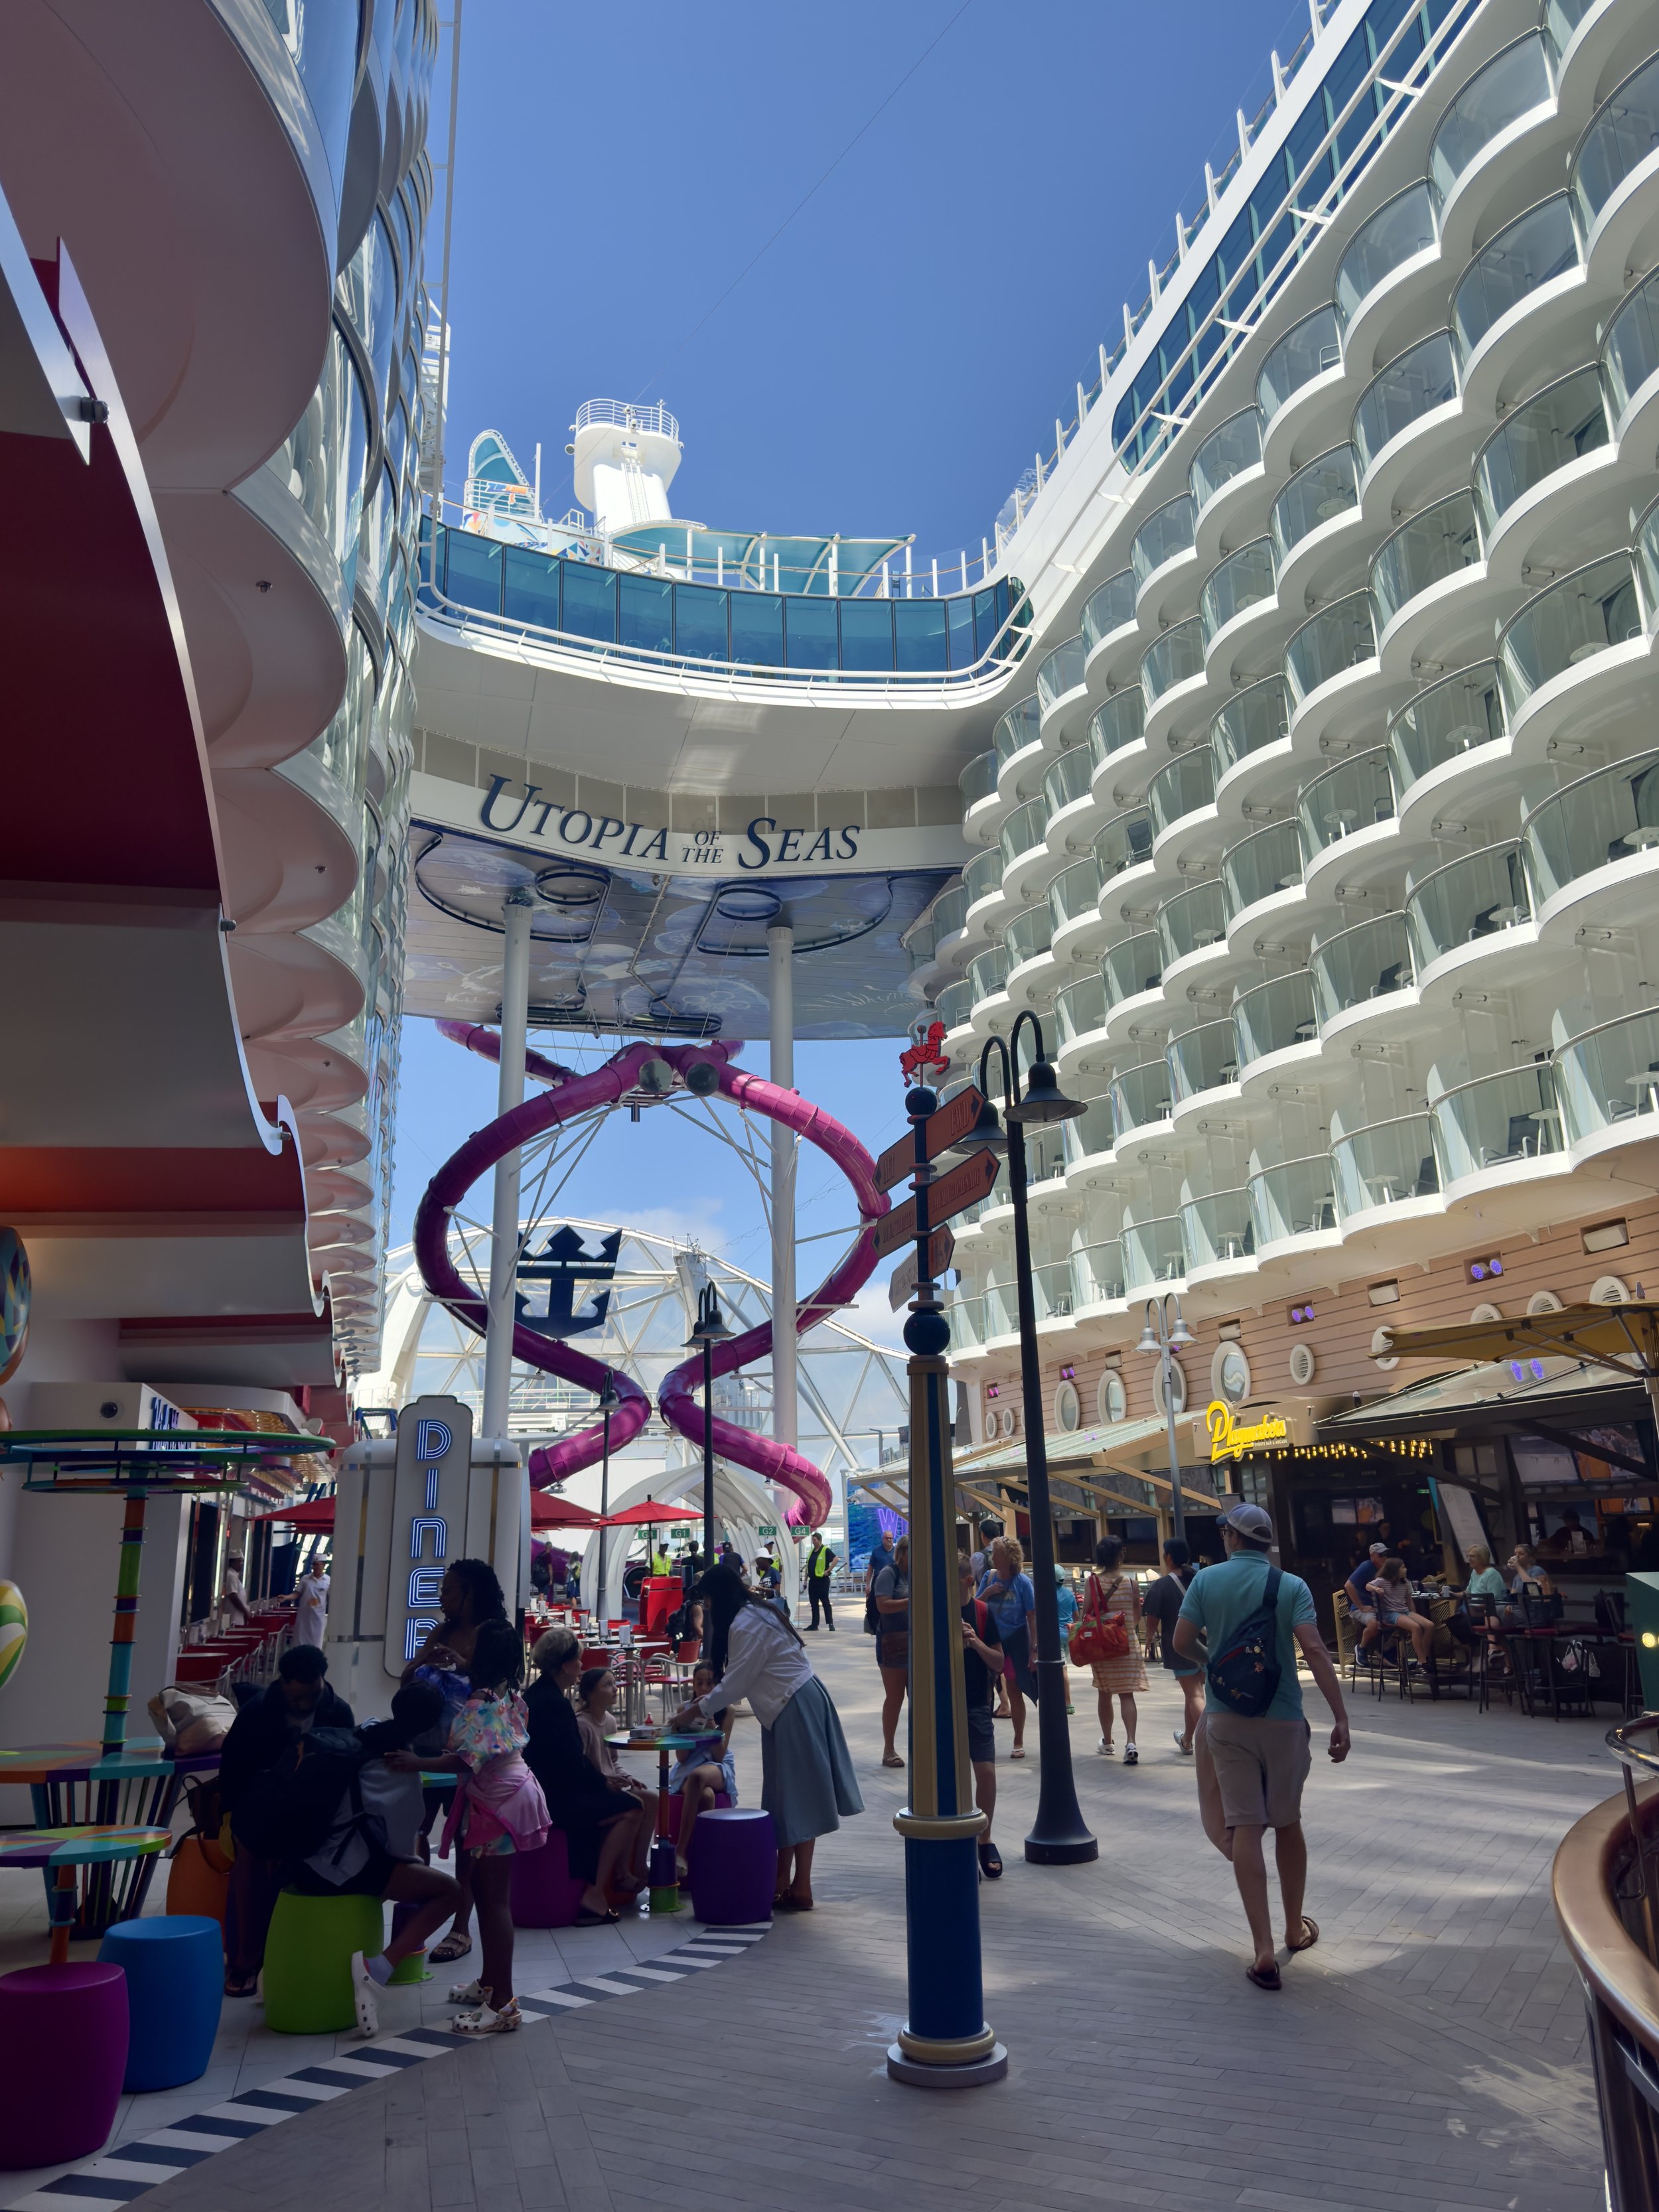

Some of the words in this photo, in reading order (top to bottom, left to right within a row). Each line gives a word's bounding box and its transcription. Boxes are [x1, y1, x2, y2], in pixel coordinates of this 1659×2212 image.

[480, 773, 669, 861] UTOPIA
[682, 847, 724, 864] THE
[694, 830, 722, 846] OF
[737, 817, 861, 870] SEAS
[950, 1099, 970, 1137] FWD
[1206, 1401, 1287, 1462] Playmakers
[405, 1419, 453, 1660] DINER
[763, 1527, 773, 1535] G2
[796, 1527, 806, 1535] G4
